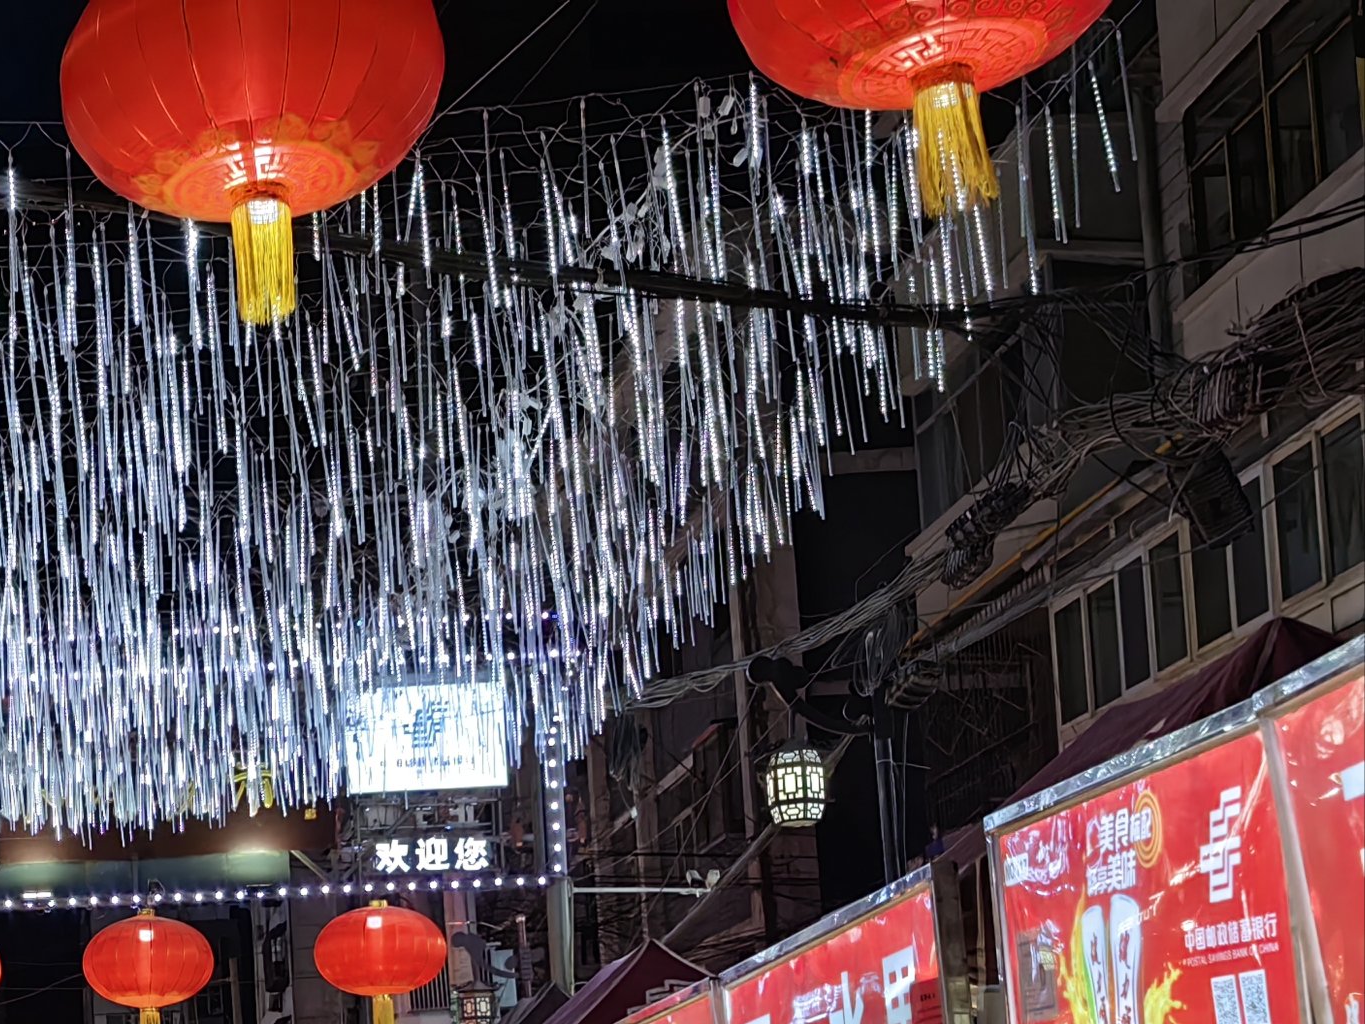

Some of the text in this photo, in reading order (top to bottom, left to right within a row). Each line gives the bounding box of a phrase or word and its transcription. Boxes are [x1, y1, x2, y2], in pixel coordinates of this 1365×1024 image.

[375, 836, 490, 874] 欢迎您
[1184, 913, 1278, 952] 中国邮政储蓄银行
